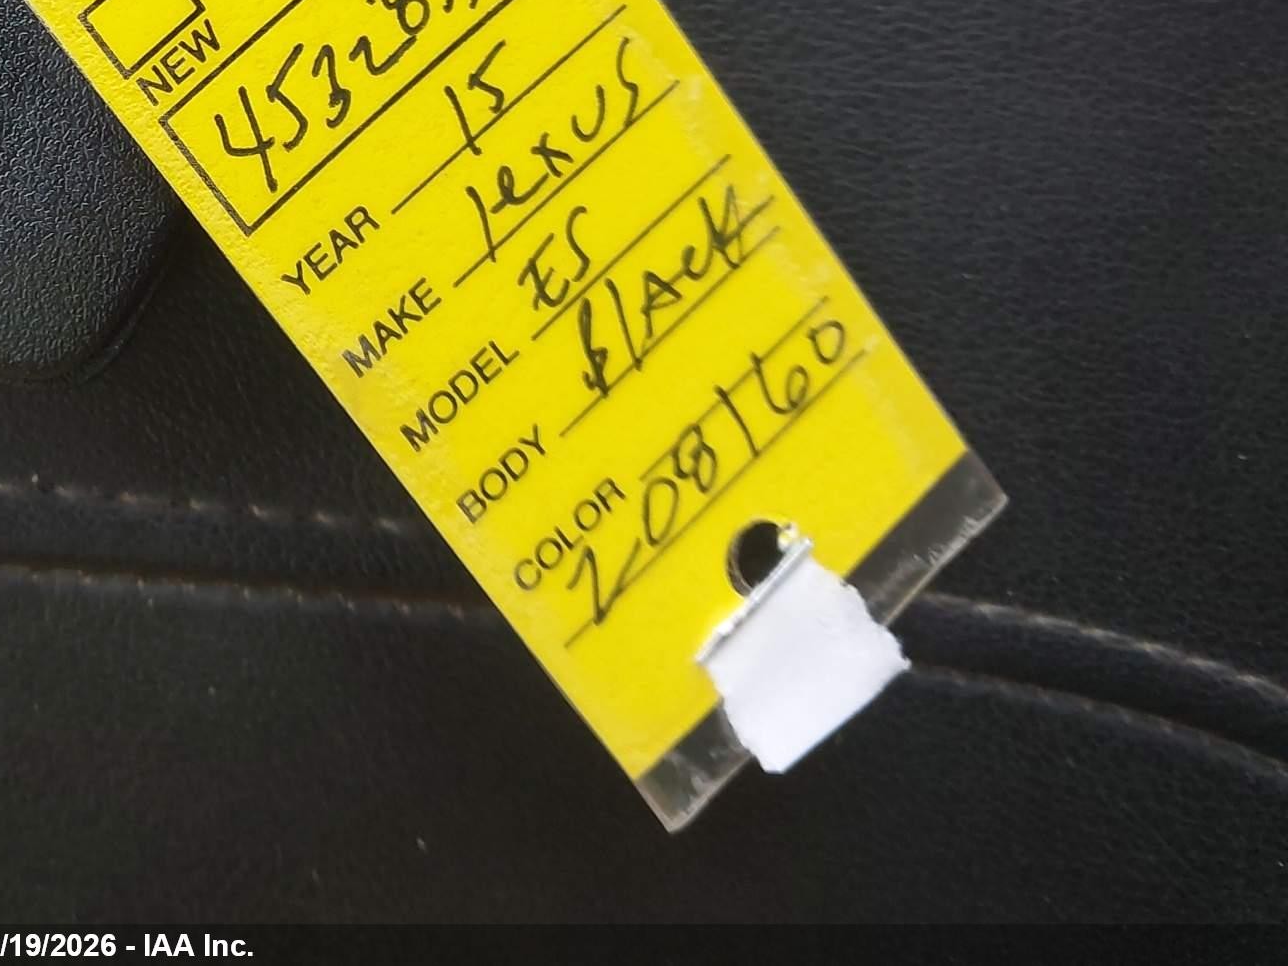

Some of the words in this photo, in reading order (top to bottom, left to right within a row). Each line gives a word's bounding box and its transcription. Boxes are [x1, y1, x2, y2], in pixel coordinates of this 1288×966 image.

[137, 20, 220, 107] NEW
[444, 40, 507, 155] 15
[280, 205, 382, 298] YEAR
[517, 206, 592, 312] ES
[341, 279, 442, 379] MAKE
[399, 340, 520, 454] MODEL
[456, 425, 549, 525] BODY
[513, 478, 628, 593] COLOR
